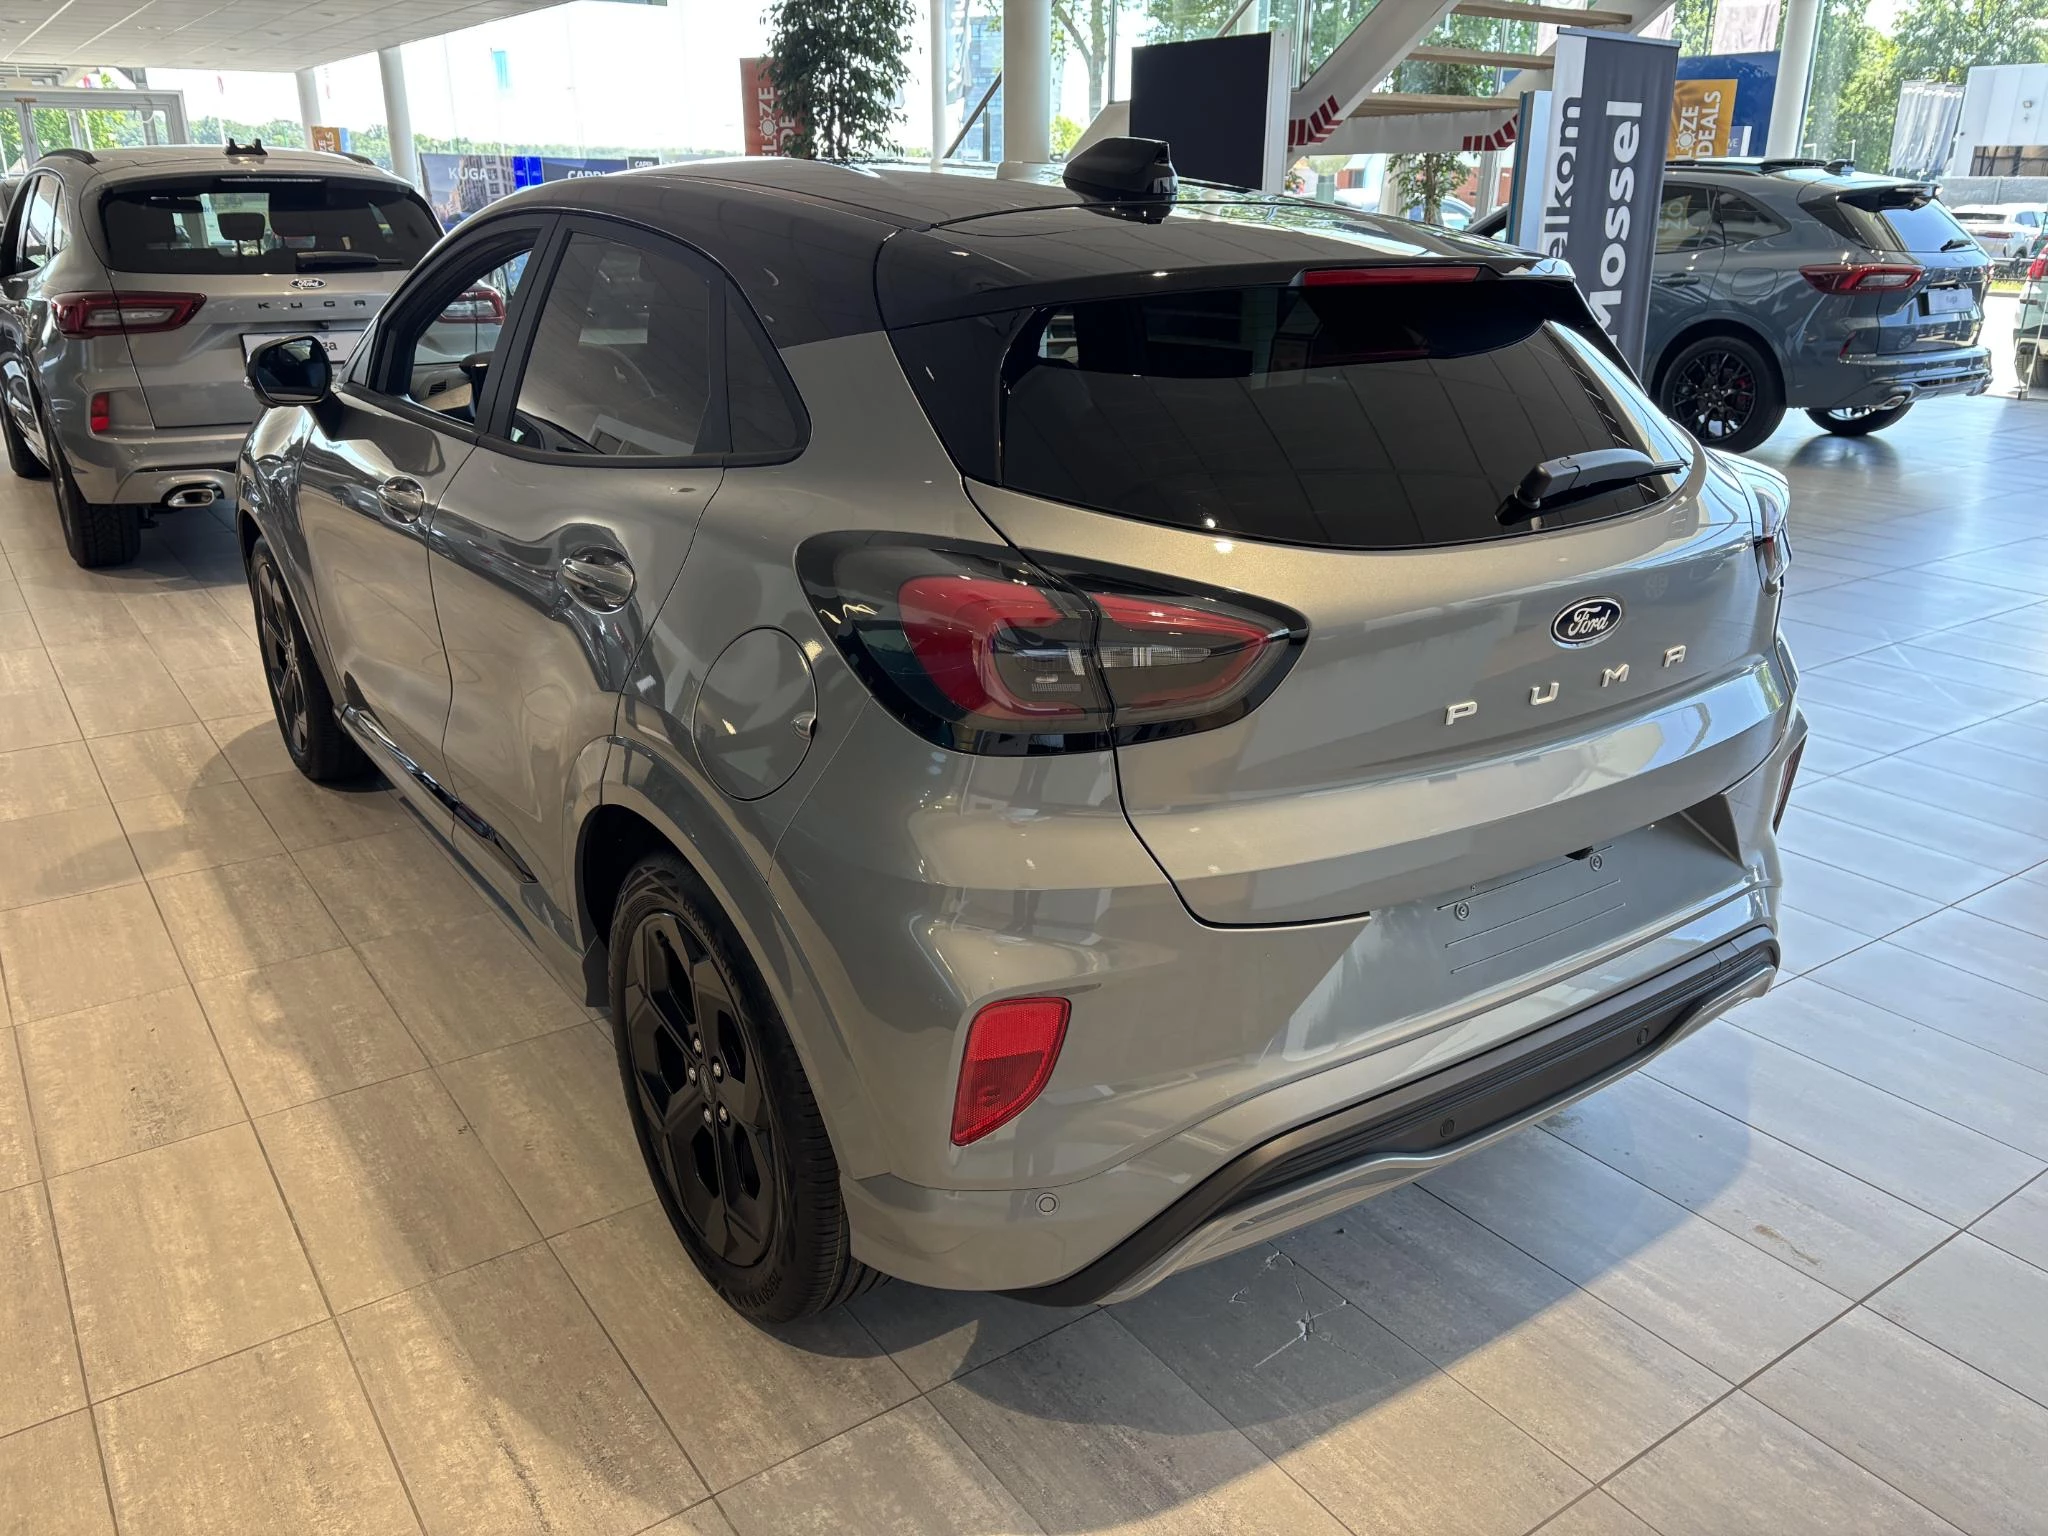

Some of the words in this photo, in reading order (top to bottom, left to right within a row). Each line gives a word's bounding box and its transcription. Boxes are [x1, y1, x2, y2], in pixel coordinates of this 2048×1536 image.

[1696, 90, 1722, 157] DEALS
[448, 167, 489, 181] KUGA
[1544, 97, 1583, 259] elkom
[1589, 101, 1643, 346] Mossel
[258, 300, 366, 309] KUGA
[1567, 605, 1612, 637] Ford
[1445, 645, 1687, 726] PUMA
